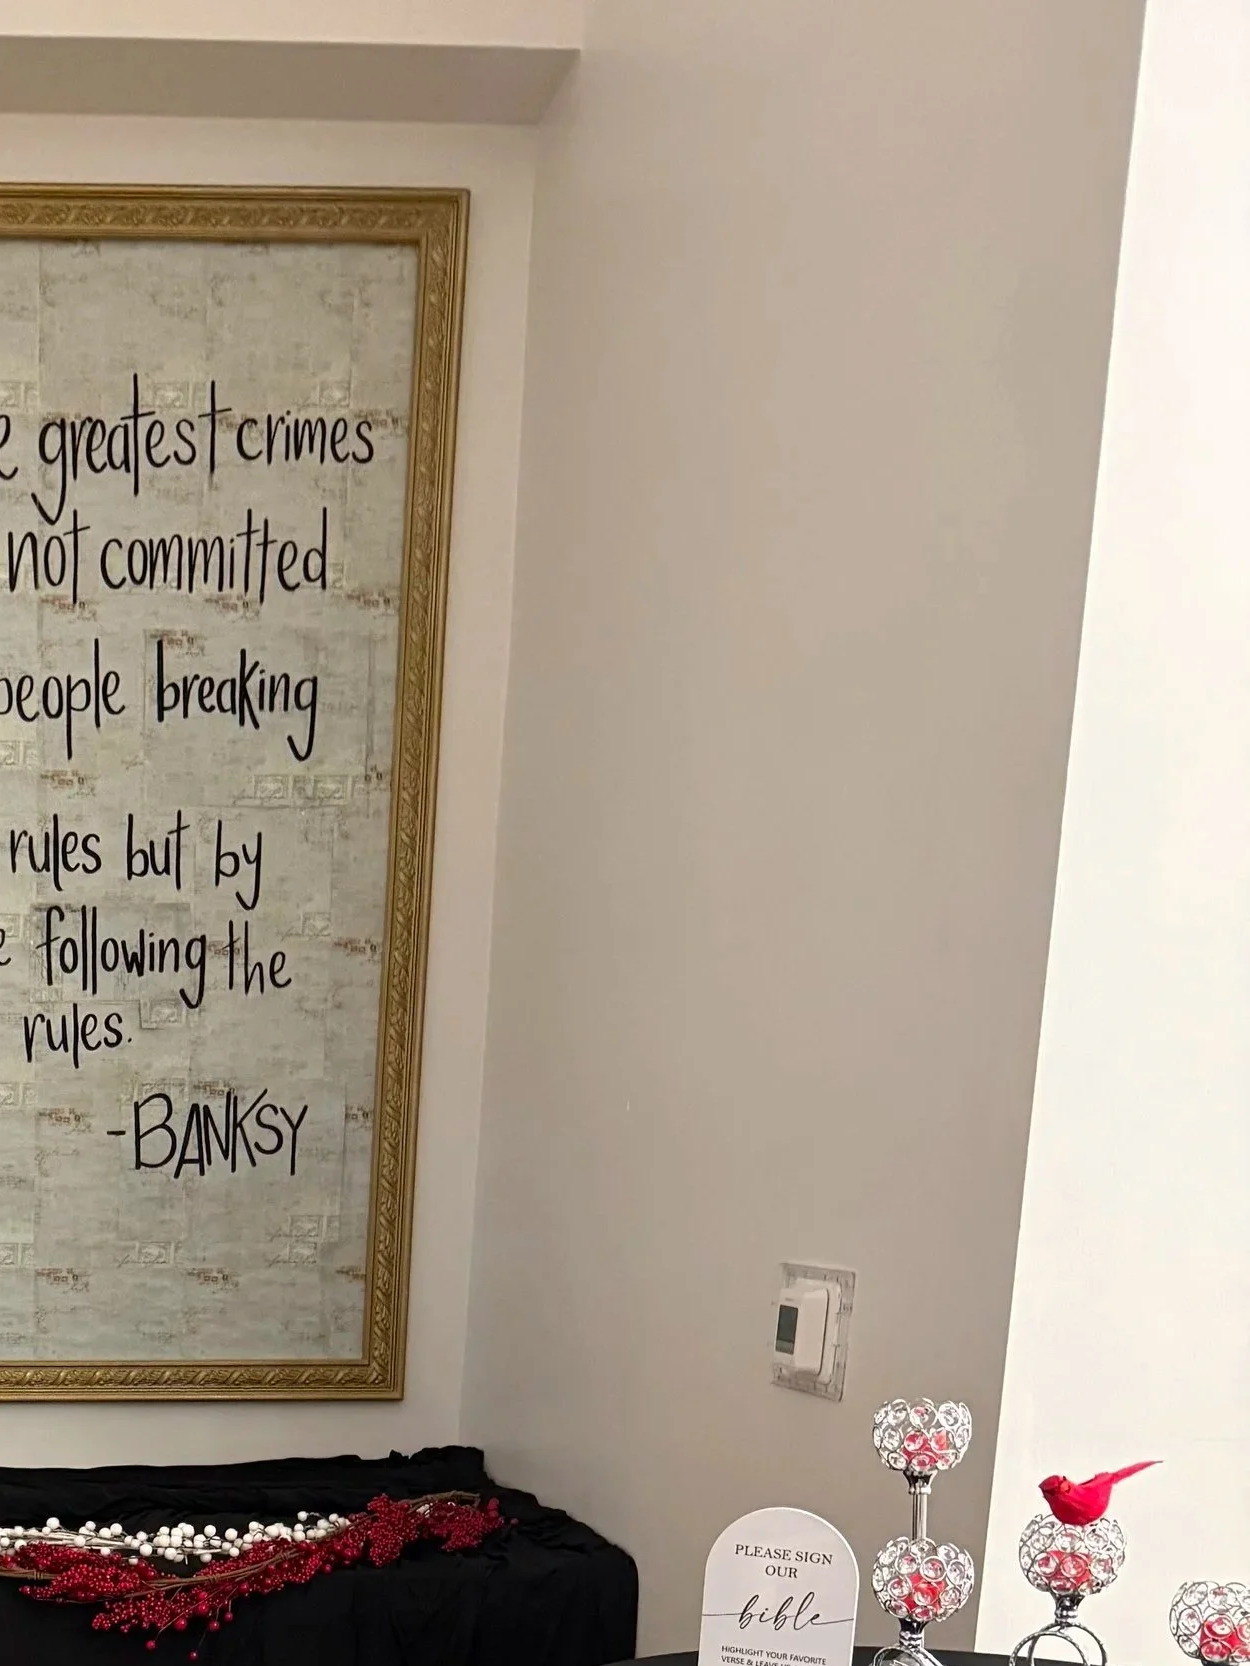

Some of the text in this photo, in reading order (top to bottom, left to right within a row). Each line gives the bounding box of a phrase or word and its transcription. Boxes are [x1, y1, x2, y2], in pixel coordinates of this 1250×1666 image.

[31, 372, 233, 525] greatest
[236, 410, 375, 465] crimes
[7, 508, 91, 604] not
[99, 506, 328, 605] committed
[155, 639, 318, 762] breaking
[9, 813, 103, 892] rules
[127, 809, 190, 890] but
[214, 820, 263, 911] by
[35, 904, 208, 1009] following
[221, 920, 293, 996] the
[23, 1003, 134, 1069] rules.
[735, 1544, 833, 1565] PLEASE SIGN
[765, 1565, 798, 1578] OUR
[721, 1645, 826, 1665] HIGHLIGHT YOUR FAVORITE
[721, 1655, 744, 1665] VERSE
